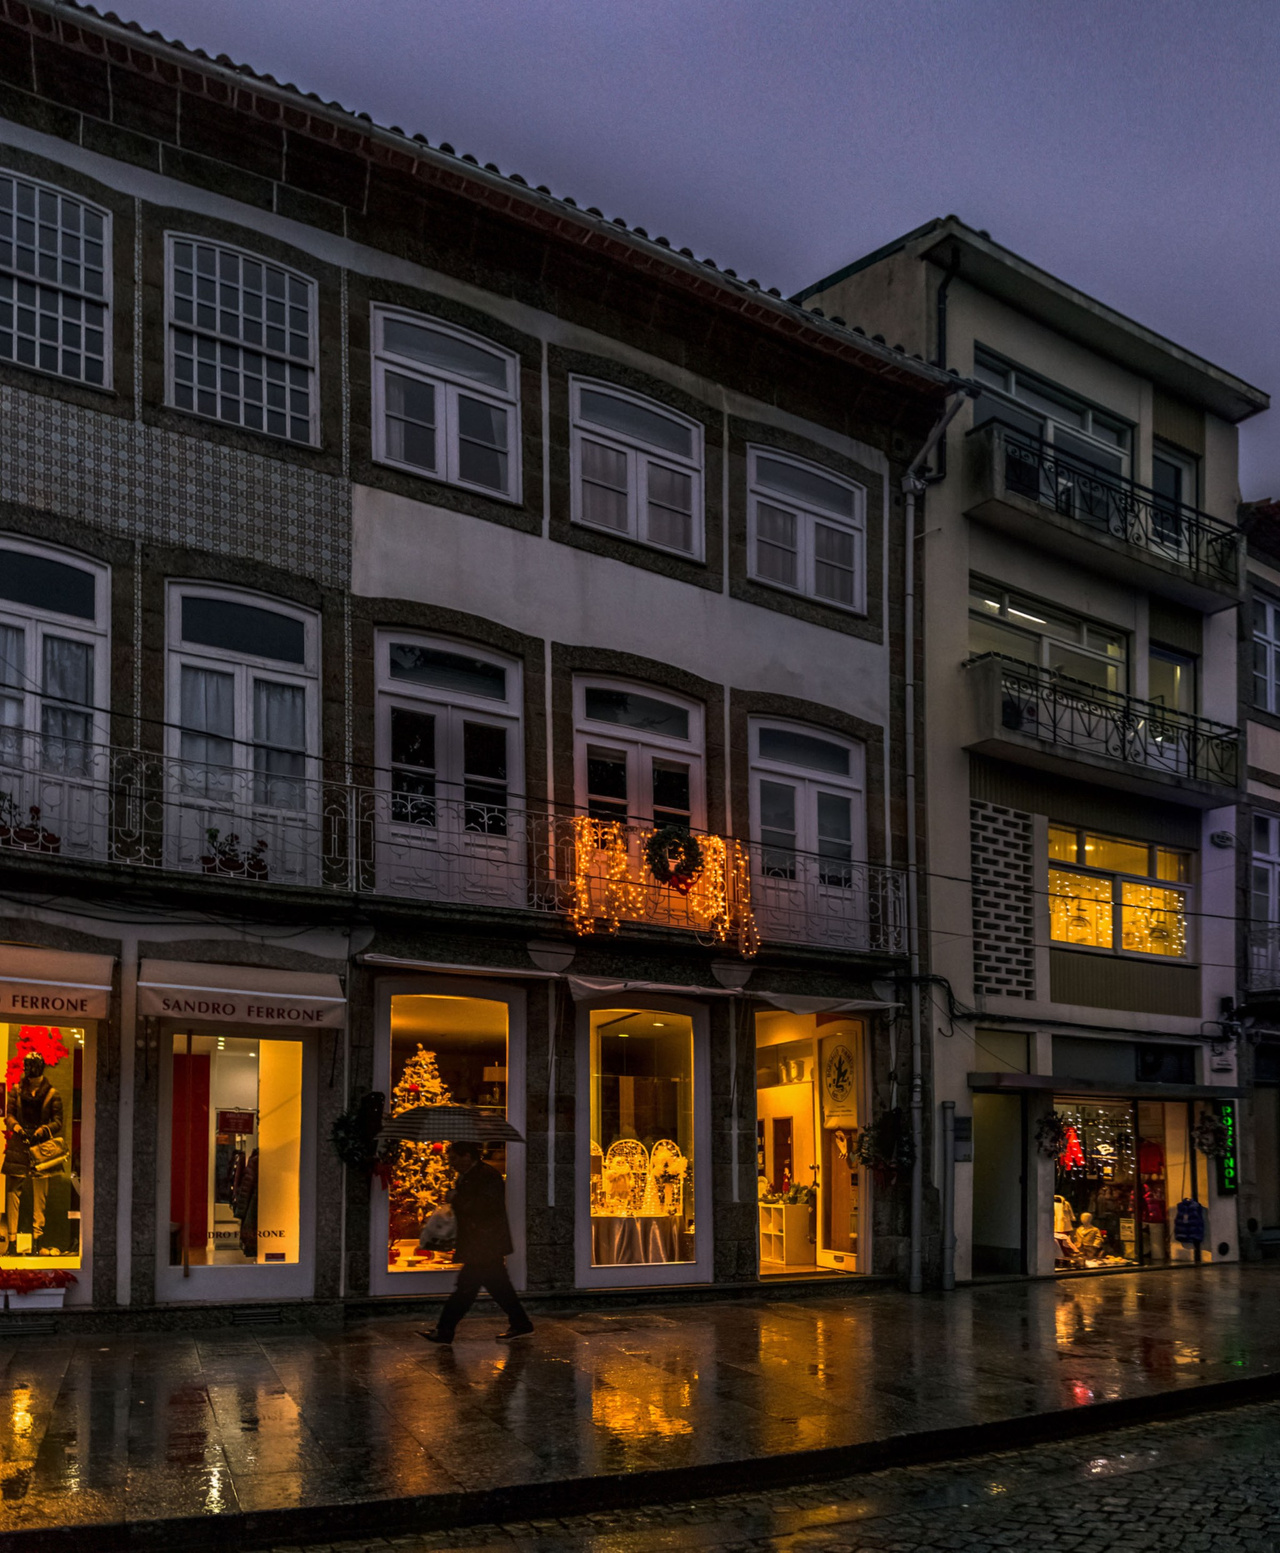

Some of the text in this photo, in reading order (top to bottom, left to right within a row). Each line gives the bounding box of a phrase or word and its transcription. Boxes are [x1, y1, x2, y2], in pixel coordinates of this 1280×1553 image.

[12, 994, 88, 1012] FERRONE
[162, 998, 324, 1022] SANDRO FERRONE
[234, 1230, 286, 1239] FRONE
